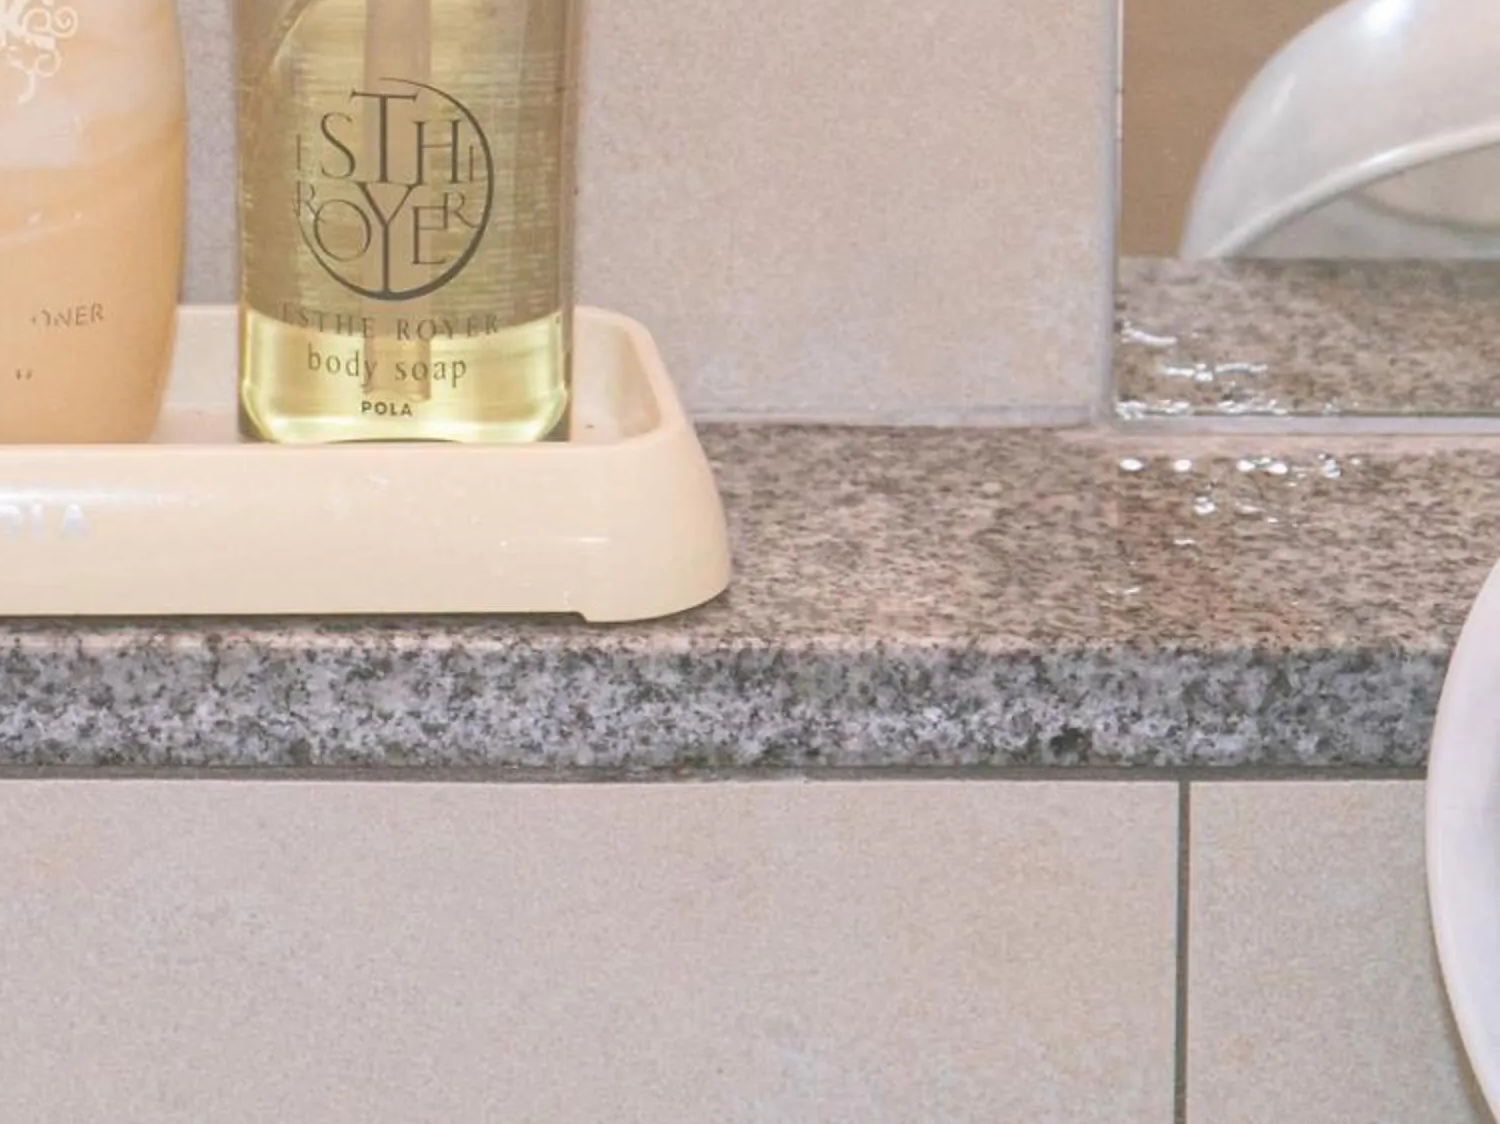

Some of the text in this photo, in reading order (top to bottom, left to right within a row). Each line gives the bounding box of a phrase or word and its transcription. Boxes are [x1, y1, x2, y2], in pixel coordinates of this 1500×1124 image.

[280, 304, 500, 342] ESTHE ROYER
[307, 344, 468, 389] body soap
[361, 401, 413, 417] POLA
